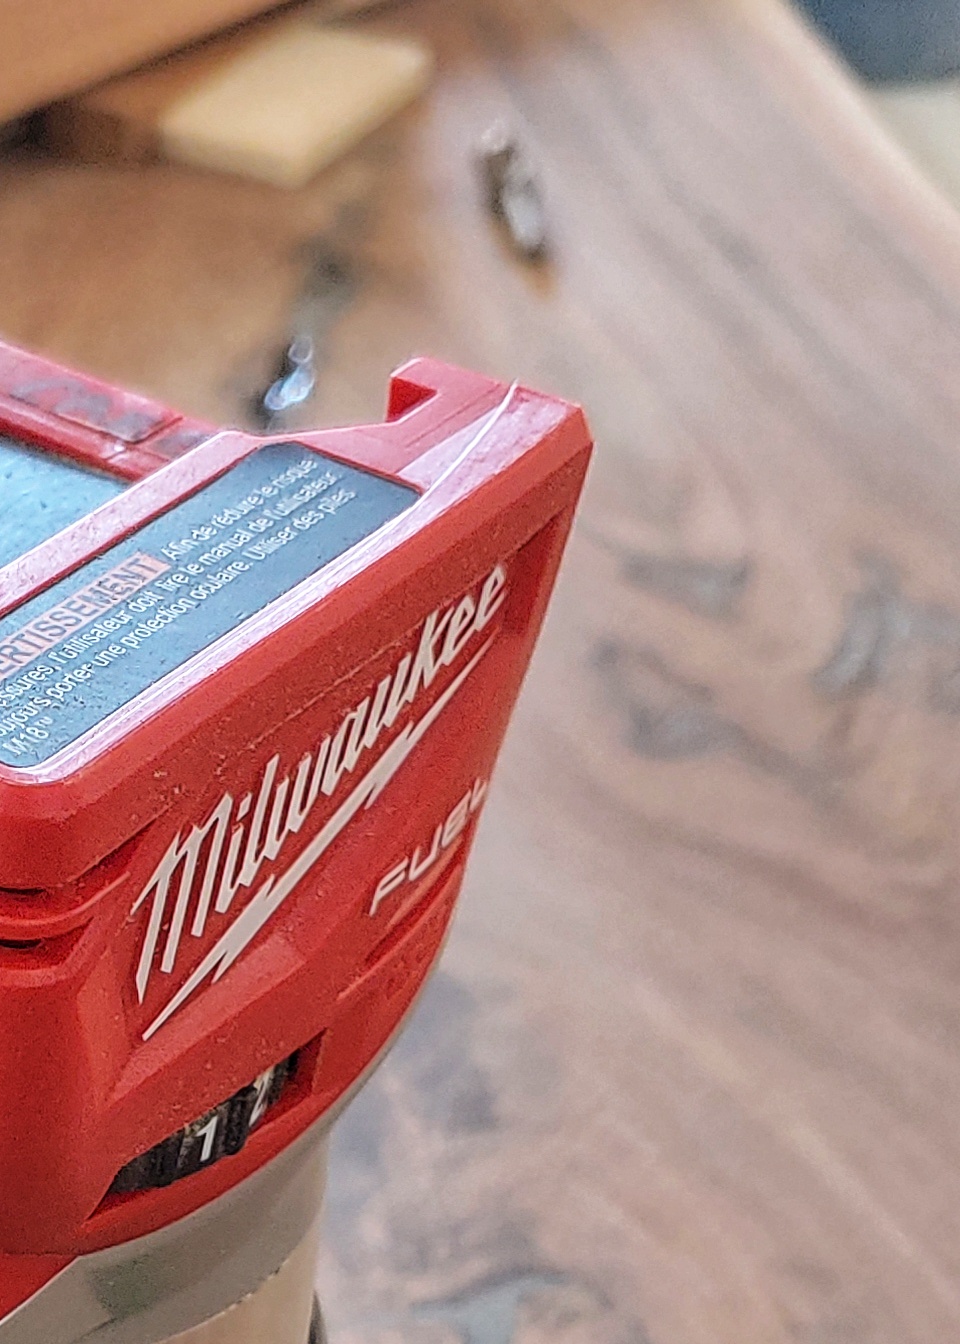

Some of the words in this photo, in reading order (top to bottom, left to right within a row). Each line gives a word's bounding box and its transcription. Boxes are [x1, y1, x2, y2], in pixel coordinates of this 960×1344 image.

[90, 642, 127, 667] une
[119, 597, 197, 649] protection
[292, 510, 325, 530] des
[126, 590, 165, 613] doit
[177, 563, 205, 576] le
[248, 518, 274, 533] de
[160, 539, 199, 561] Afin
[191, 526, 218, 541] de
[131, 563, 506, 1005] Milwaukee
[369, 778, 488, 917] FUEL
